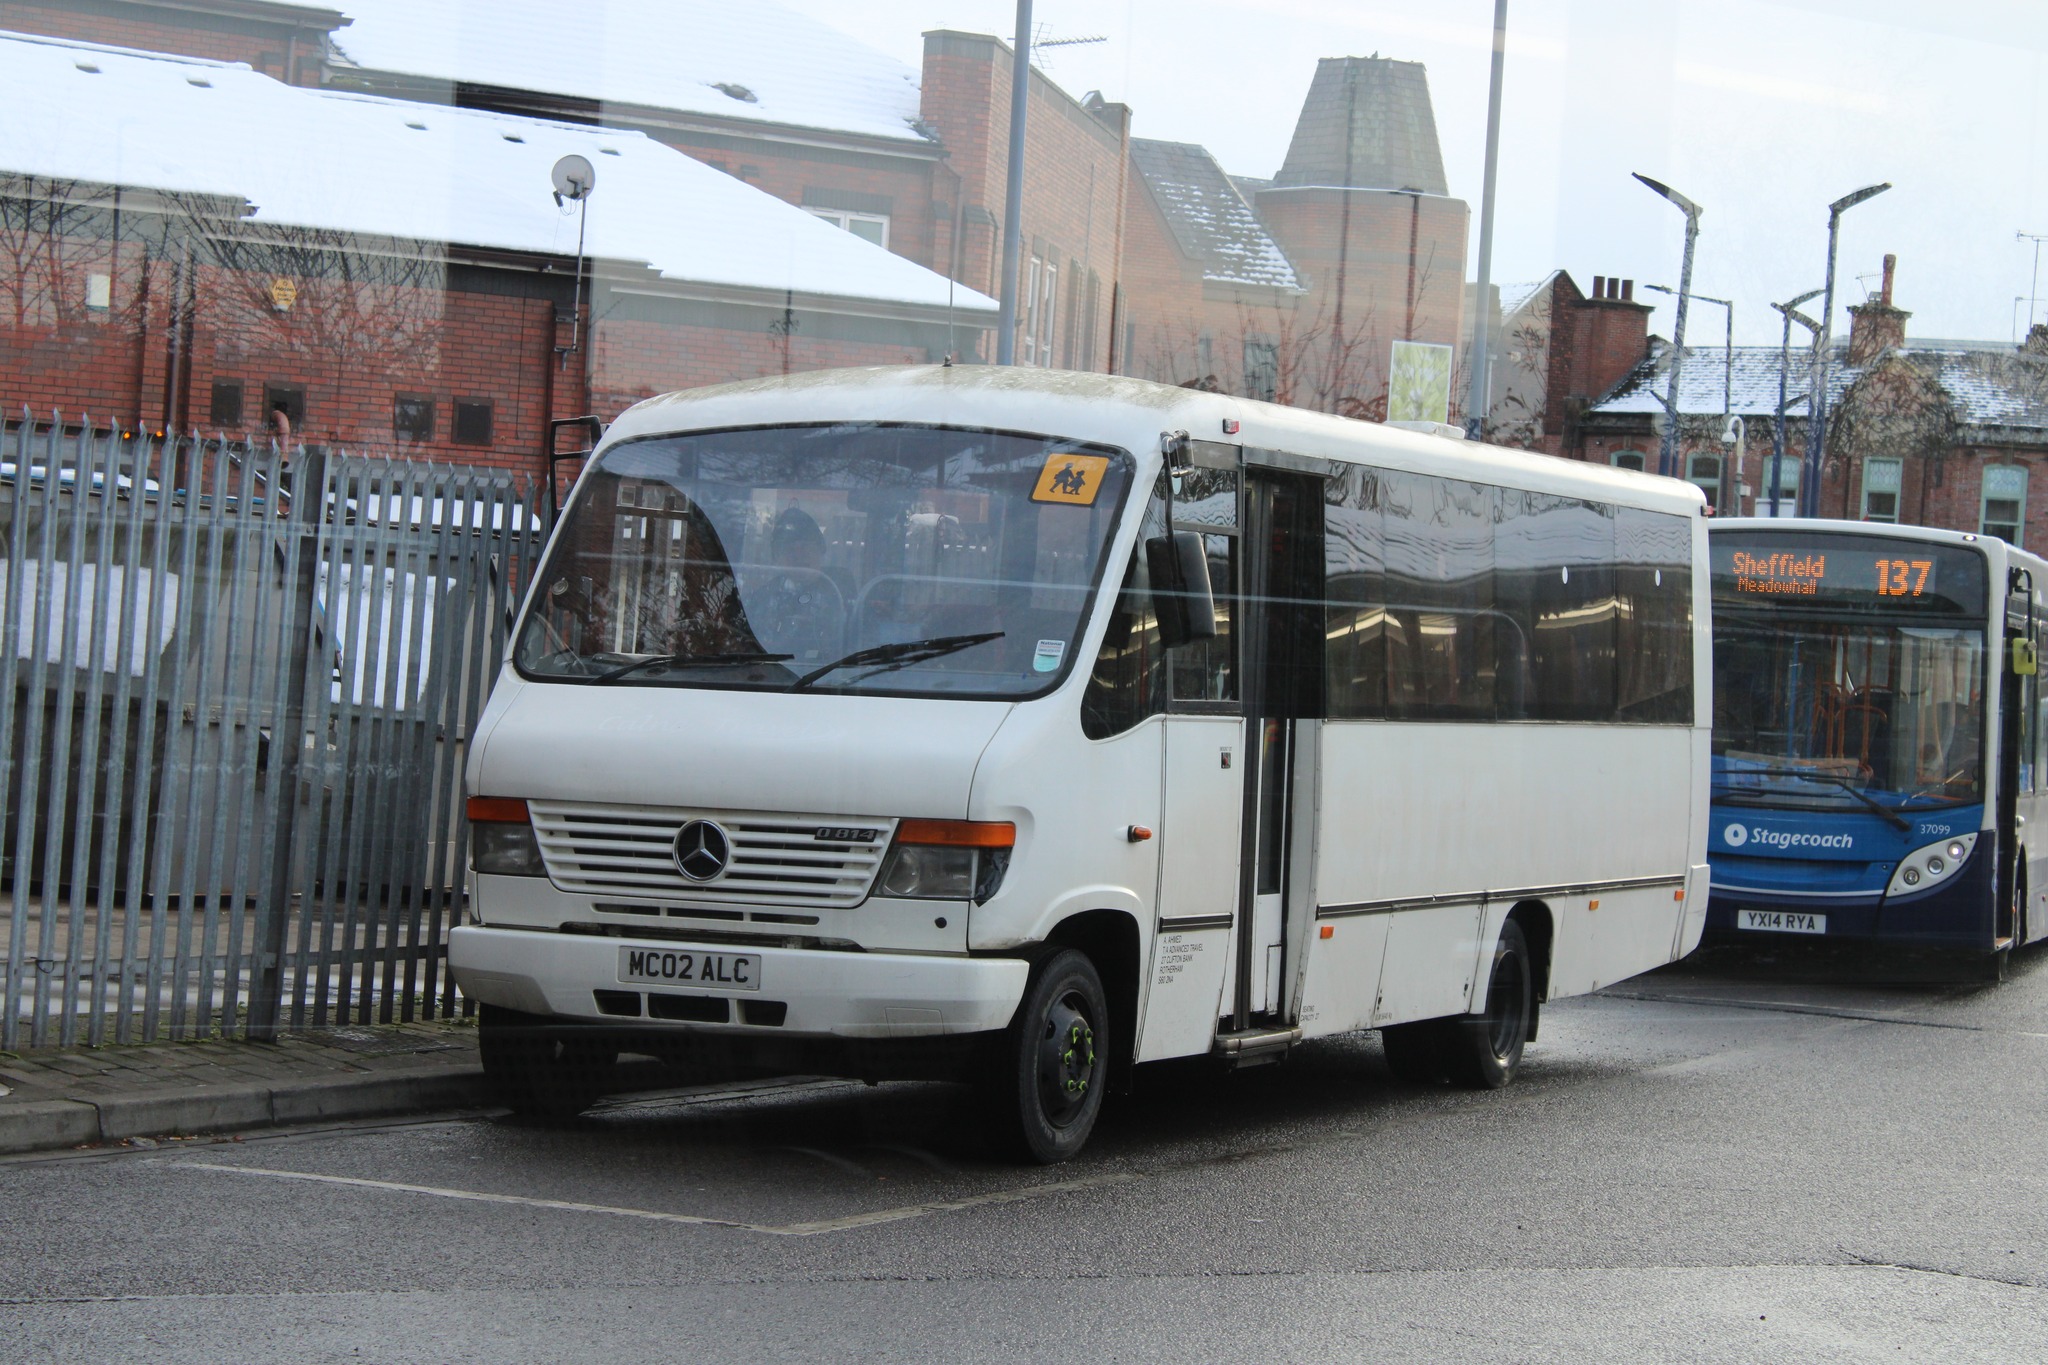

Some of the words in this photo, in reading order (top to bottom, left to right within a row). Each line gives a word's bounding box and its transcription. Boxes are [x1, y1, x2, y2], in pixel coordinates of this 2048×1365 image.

[1733, 552, 1825, 578] Sheffield
[1875, 559, 1932, 597] 137
[1738, 576, 1817, 595] Meadowhall
[834, 828, 876, 840] 814
[1751, 827, 1853, 850] Stagecoach
[1920, 824, 1951, 835] 37099
[1748, 911, 1782, 929] YX14
[1785, 914, 1816, 931] RYA
[628, 951, 693, 980] MC02
[701, 956, 749, 983] ALC
[1159, 964, 1183, 975] ROTHERHAM
